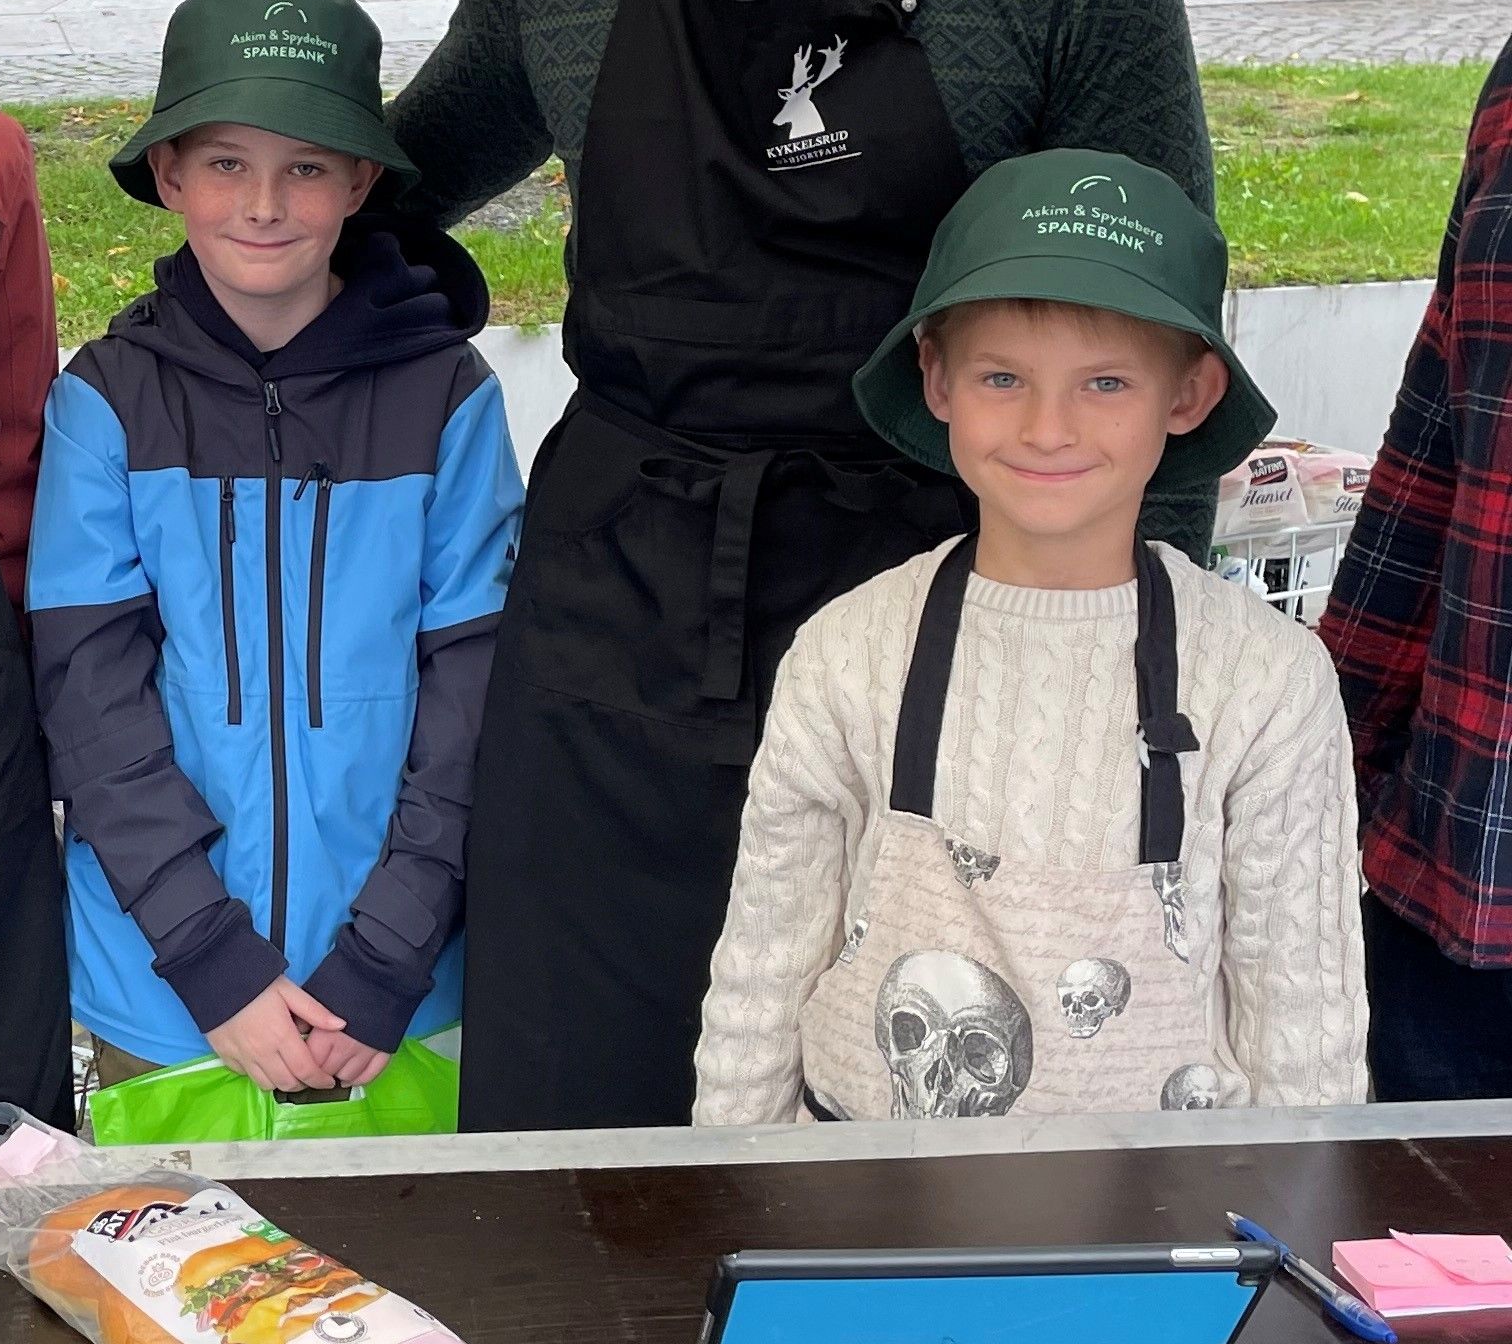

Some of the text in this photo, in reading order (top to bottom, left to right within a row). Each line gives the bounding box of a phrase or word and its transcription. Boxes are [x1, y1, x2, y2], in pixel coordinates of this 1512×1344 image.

[230, 29, 338, 55] Askim & Spydeberg
[243, 46, 325, 65] SPAREBANK
[766, 130, 849, 158] KYKKELSRUD
[1022, 204, 1163, 246] Askim & Spydeberg
[1037, 221, 1145, 254] SPAREBANK
